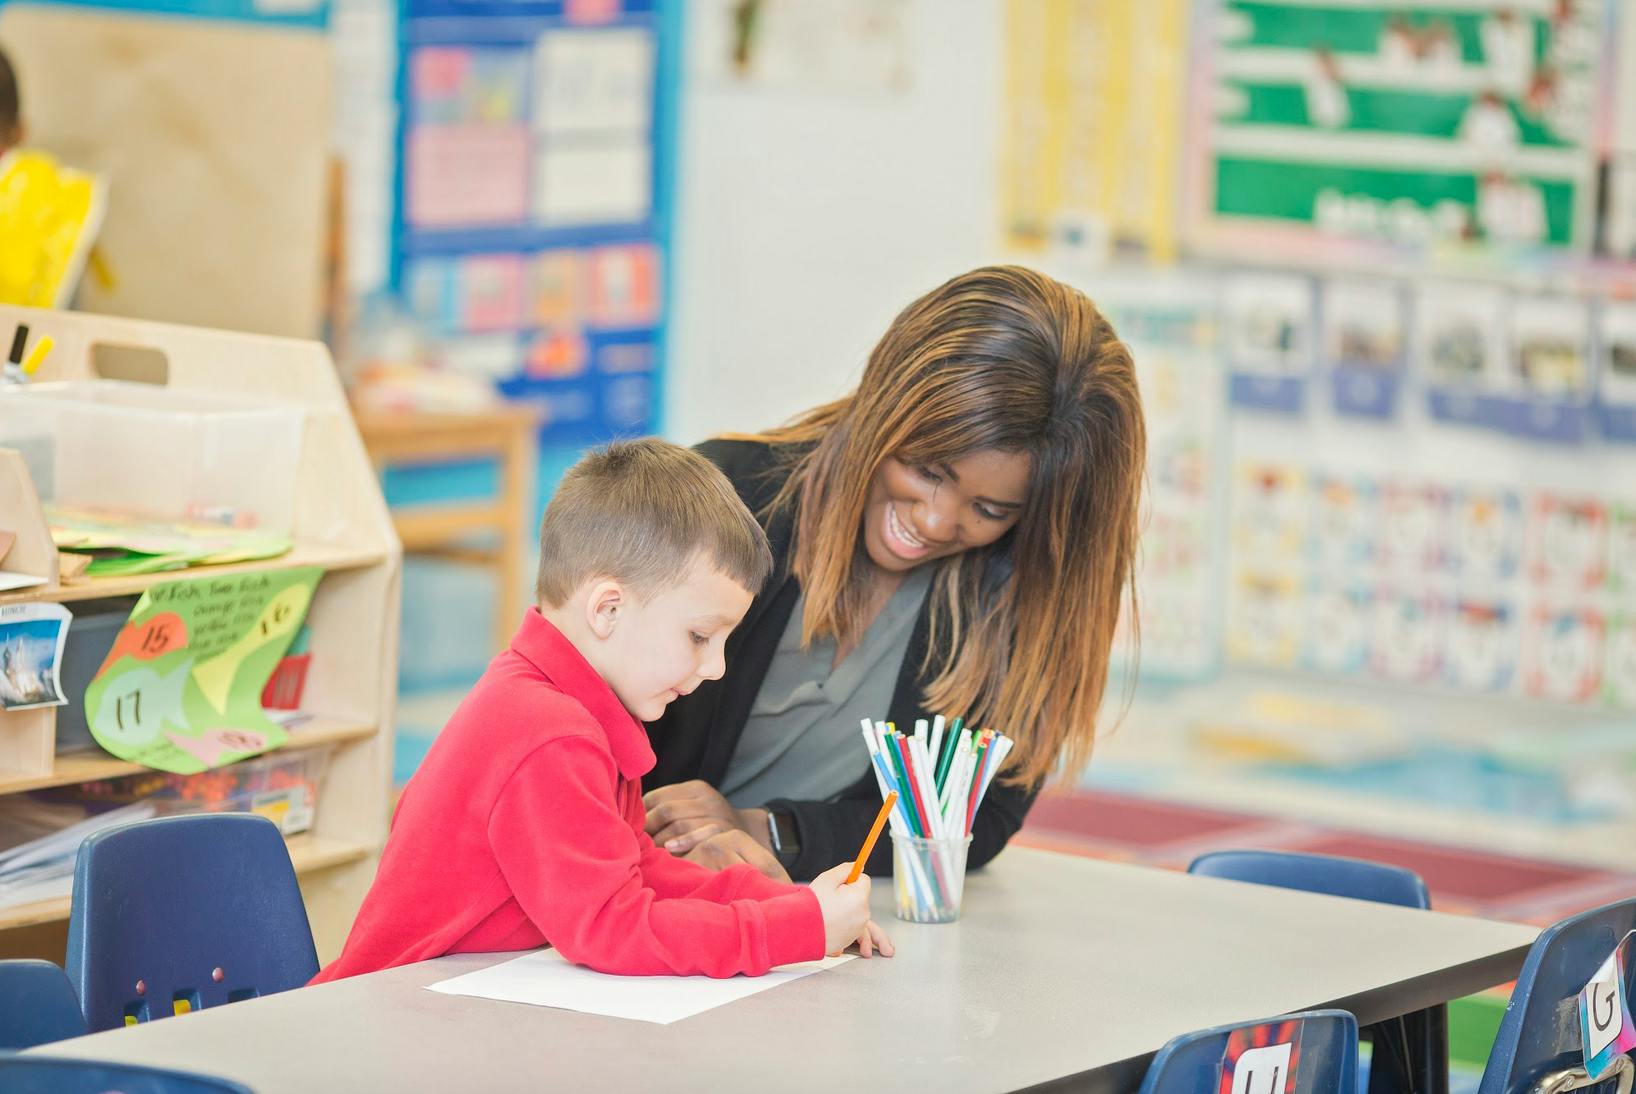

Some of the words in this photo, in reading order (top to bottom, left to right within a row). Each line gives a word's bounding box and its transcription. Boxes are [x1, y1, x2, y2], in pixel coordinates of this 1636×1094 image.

[141, 623, 171, 654] 15
[116, 688, 141, 731] 17
[1592, 982, 1616, 1032] G
